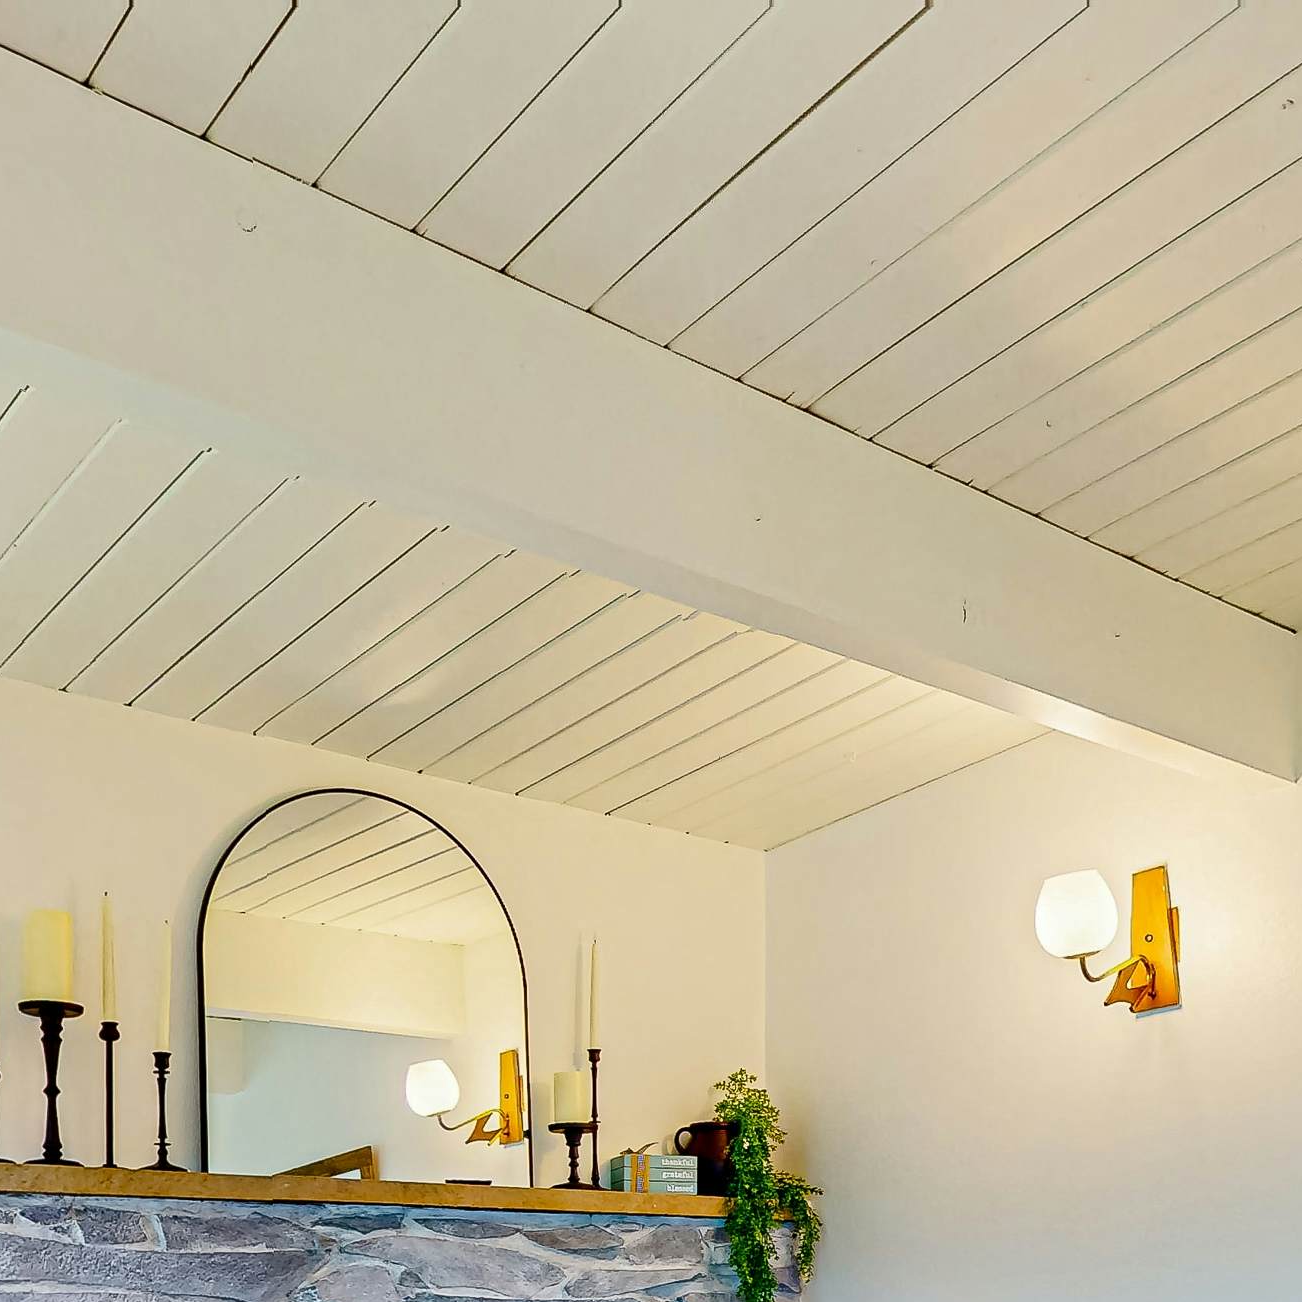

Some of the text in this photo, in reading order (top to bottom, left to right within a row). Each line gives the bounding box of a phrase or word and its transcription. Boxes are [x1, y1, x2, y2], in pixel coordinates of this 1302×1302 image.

[661, 1158, 695, 1166] thankful
[662, 1171, 694, 1179] grateful
[666, 1184, 694, 1192] blessed
